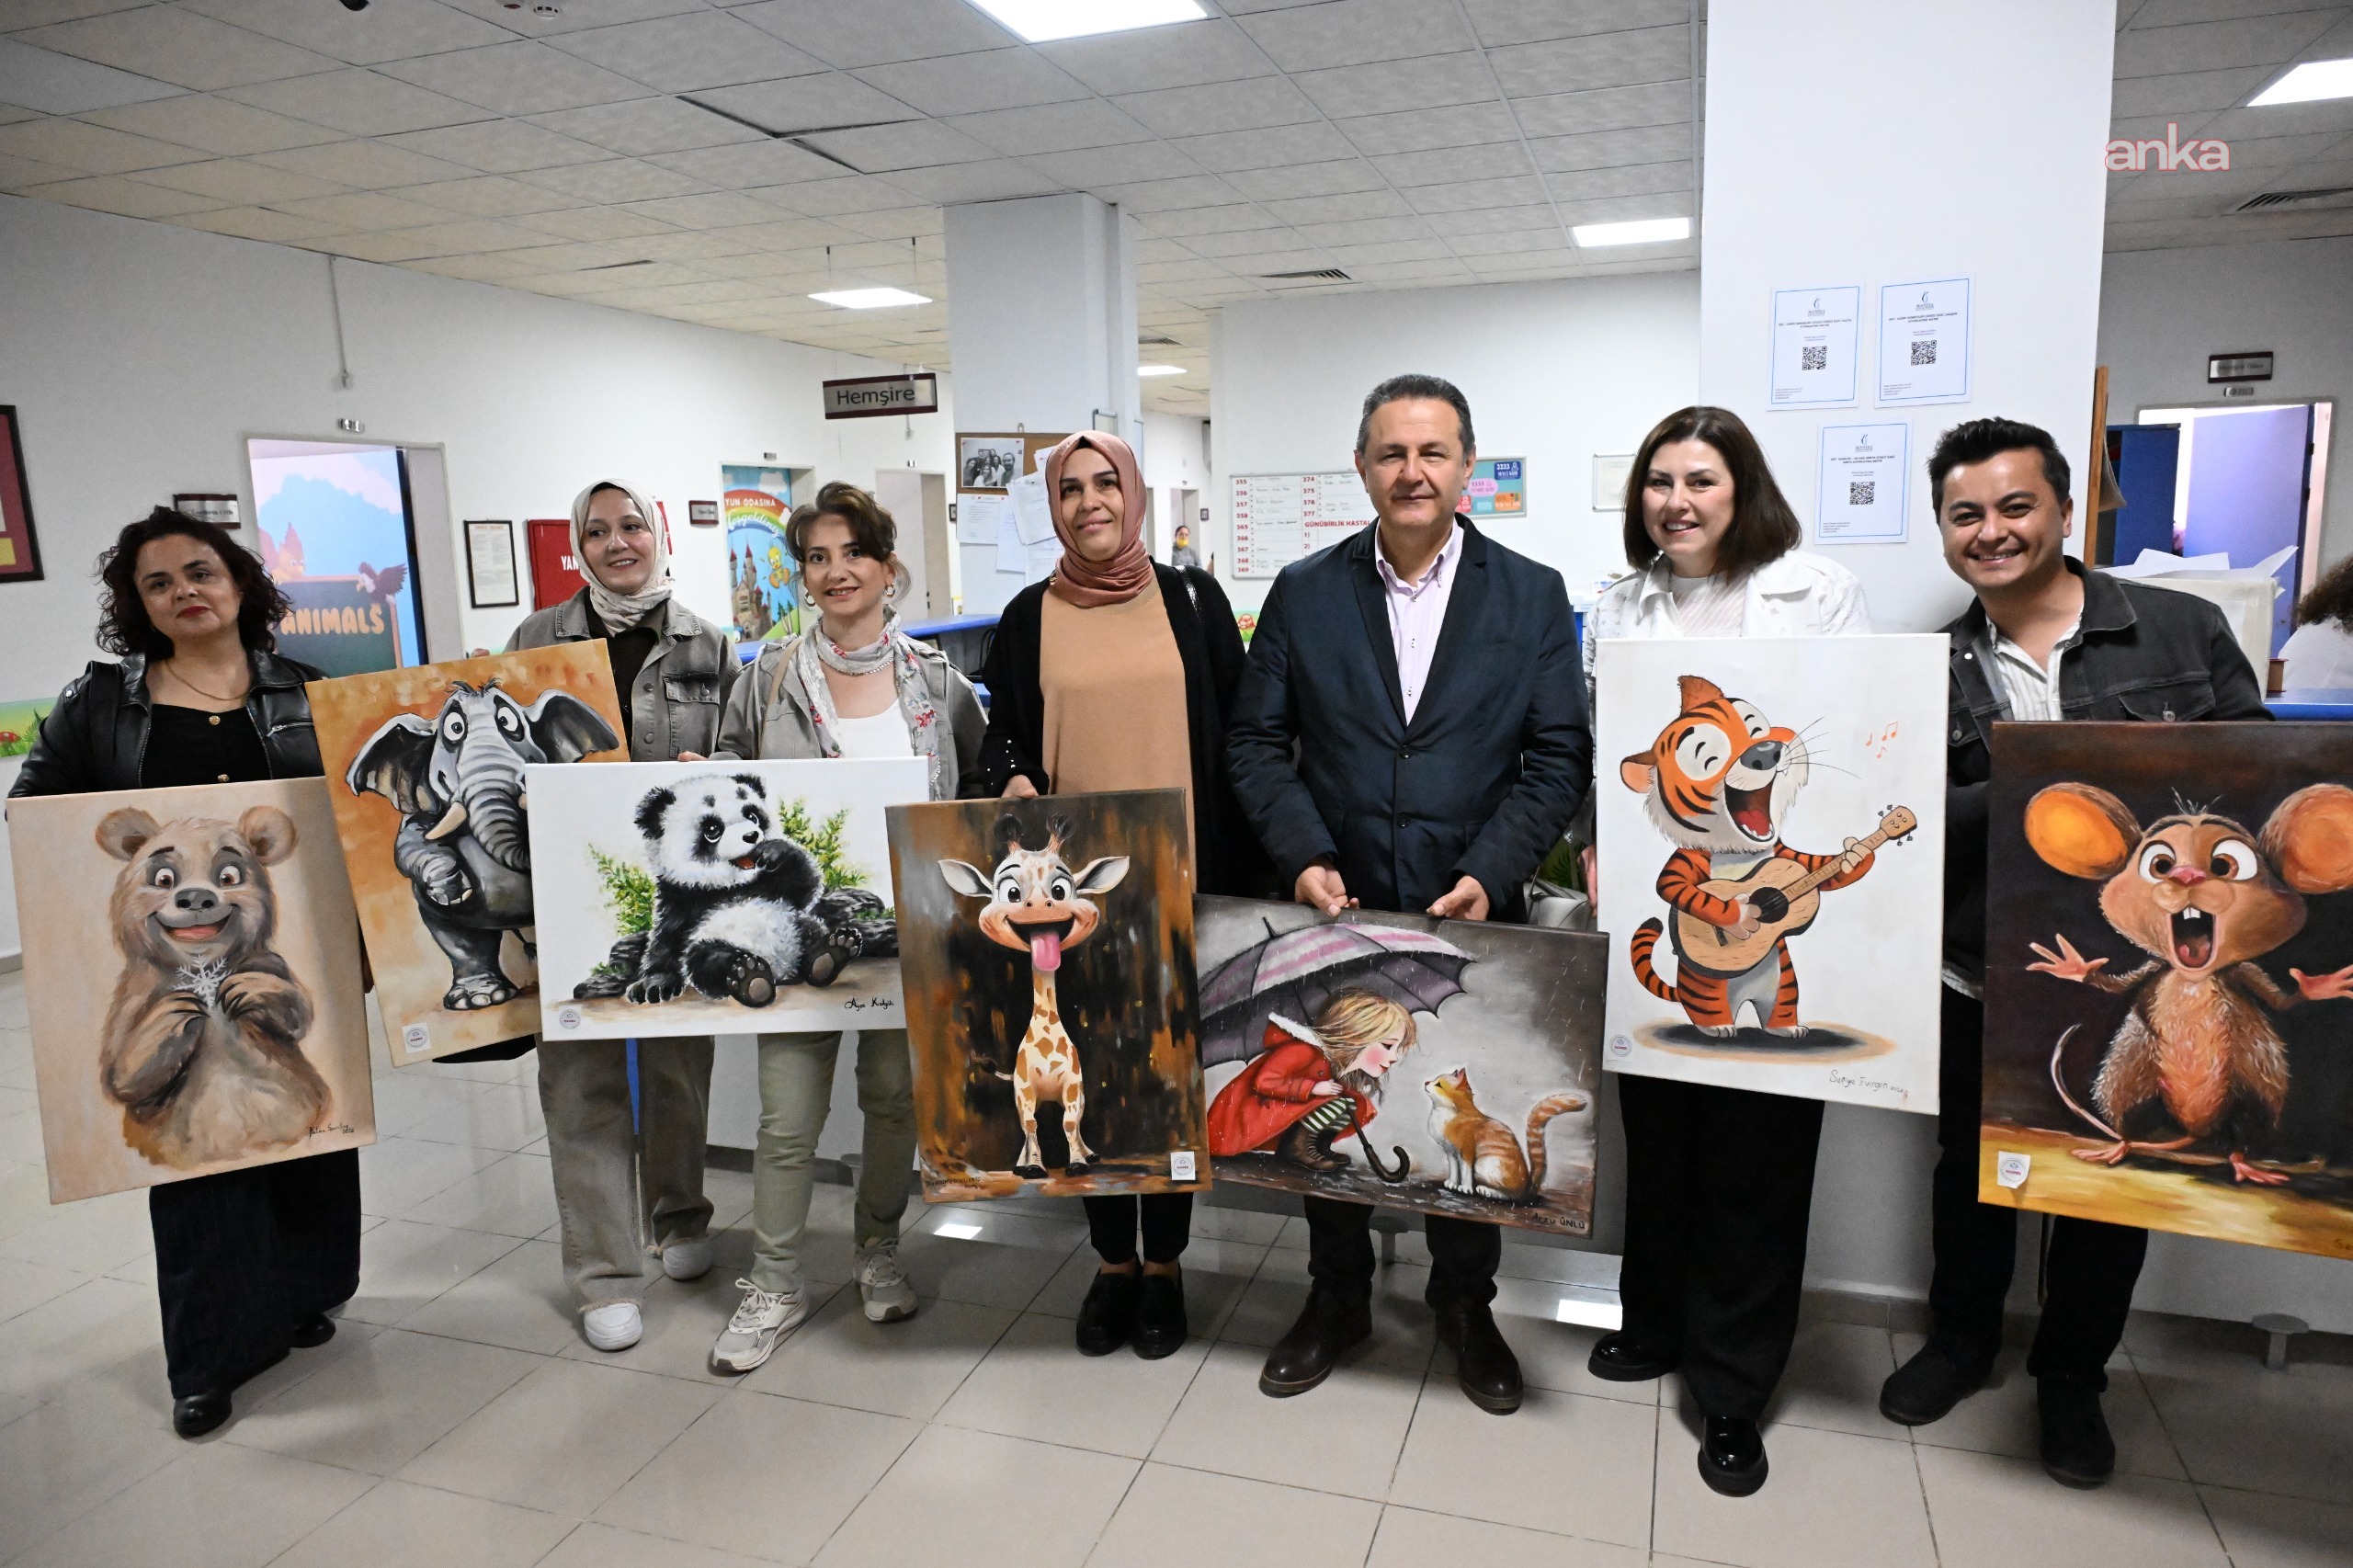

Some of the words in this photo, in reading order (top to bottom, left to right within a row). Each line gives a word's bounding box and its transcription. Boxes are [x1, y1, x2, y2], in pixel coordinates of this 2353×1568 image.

[837, 387, 915, 405] Hemşire
[724, 498, 740, 506] YUN
[743, 498, 776, 506] ODASINA
[561, 555, 579, 571] YAN
[279, 607, 384, 635] ANIMALS
[1531, 1212, 1556, 1224] Arzu
[1559, 1216, 1585, 1229] ÜNLÜ
